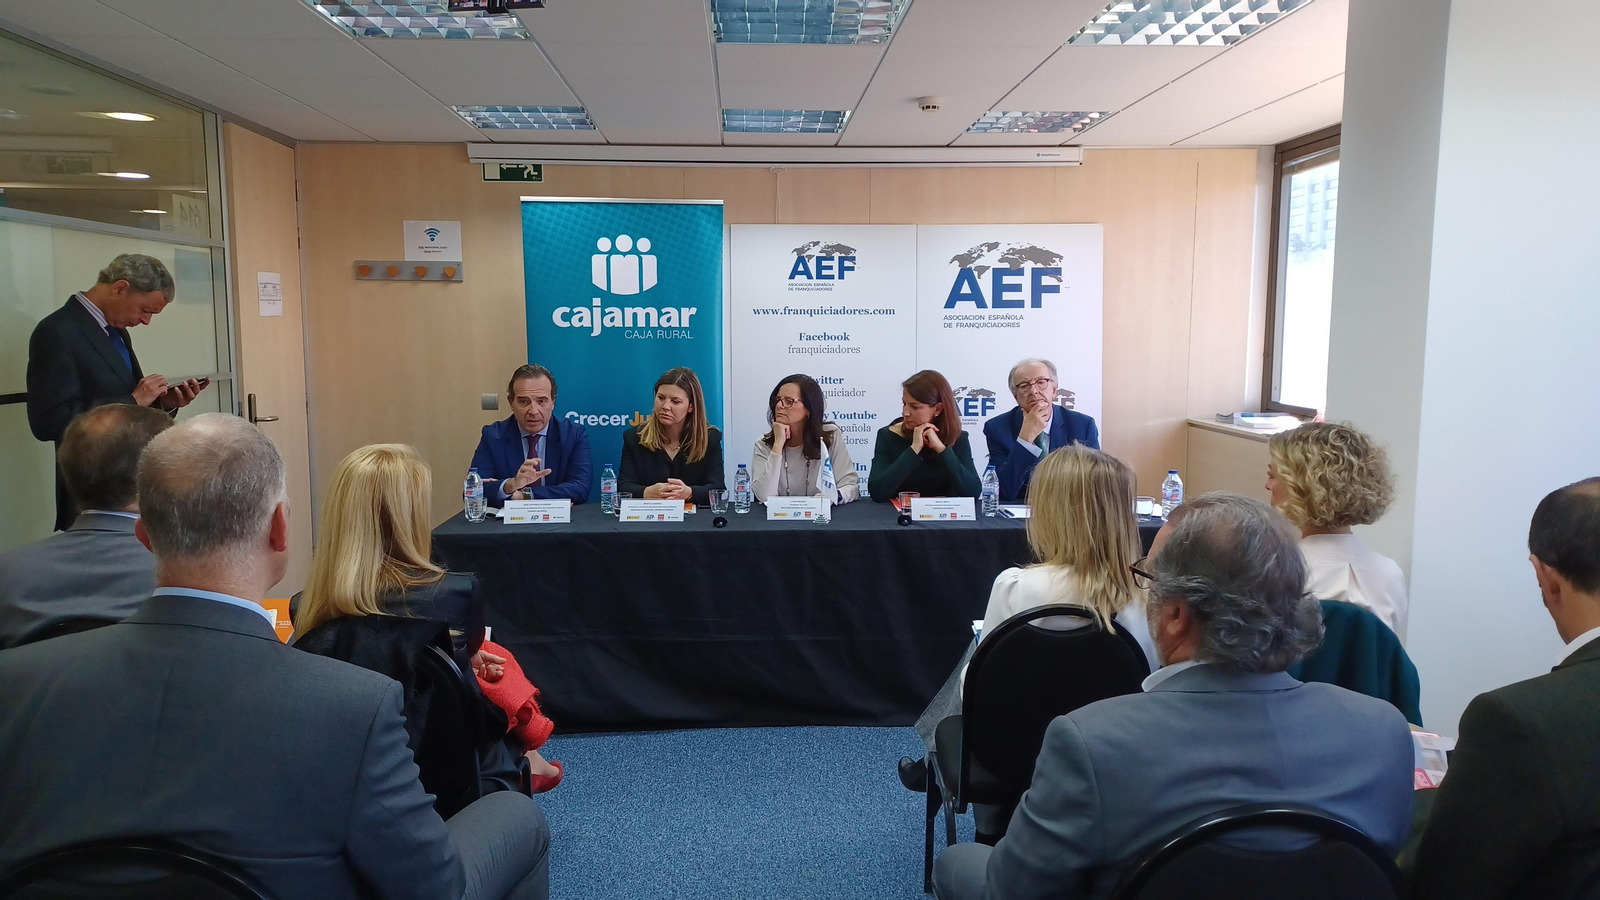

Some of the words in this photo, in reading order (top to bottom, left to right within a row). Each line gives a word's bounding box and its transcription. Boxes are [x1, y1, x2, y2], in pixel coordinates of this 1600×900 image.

[788, 255, 857, 280] AEF
[943, 266, 1063, 309] AEF
[552, 297, 698, 337] cajamar
[752, 305, 896, 318] www.franquiciadores.com
[988, 312, 1025, 321] ESPAÑOLA
[955, 321, 1021, 329] FRANQUICIADORES
[624, 329, 654, 340] CAJA
[657, 329, 694, 340] RURAL
[799, 332, 850, 342] Facebook
[788, 344, 861, 356] franquiciadores
[811, 375, 845, 385] witter
[822, 387, 866, 400] quiciador
[564, 410, 652, 427] CrecerJu
[832, 410, 878, 420] Youtube
[840, 423, 872, 435] pañola
